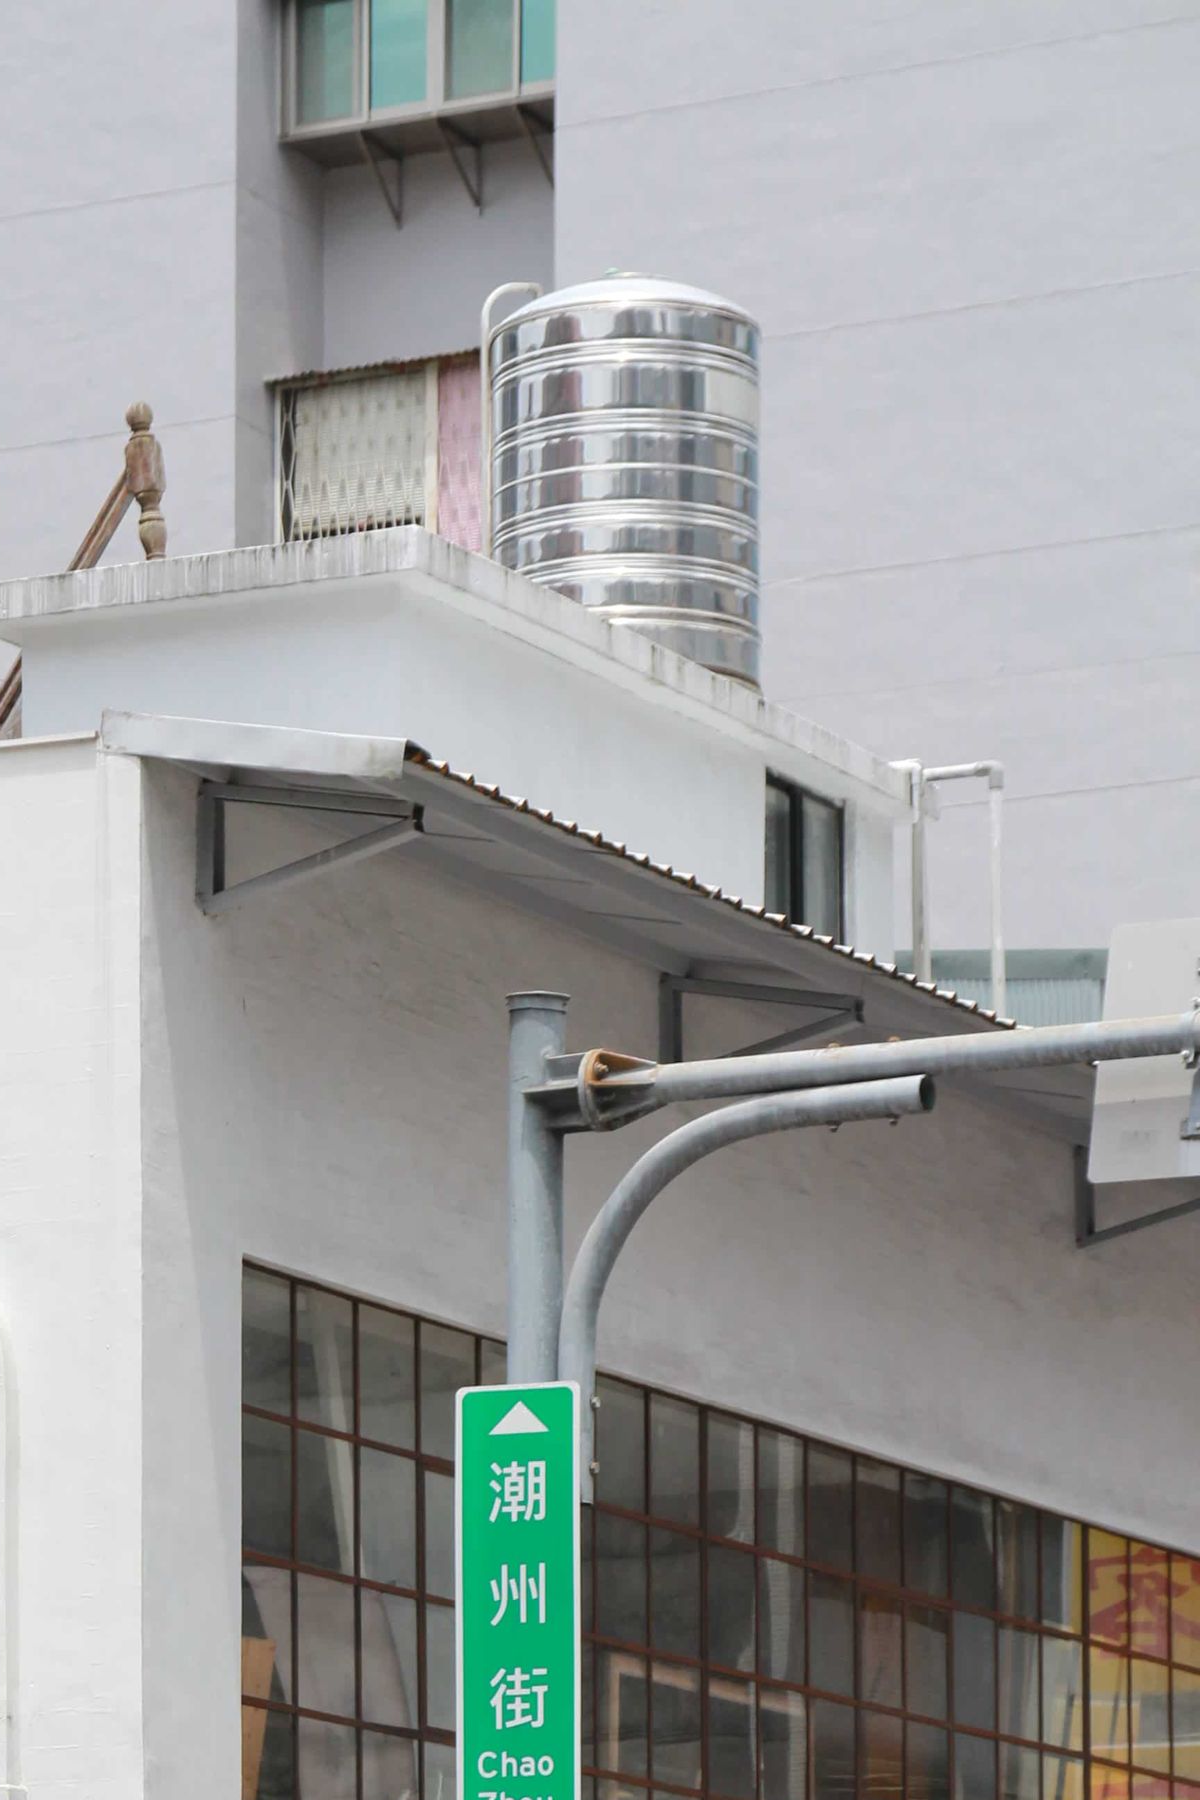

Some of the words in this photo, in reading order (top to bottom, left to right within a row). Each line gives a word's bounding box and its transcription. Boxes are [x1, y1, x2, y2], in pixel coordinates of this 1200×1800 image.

[487, 1459, 549, 1731] 潮州街
[477, 1751, 554, 1779] Chao
